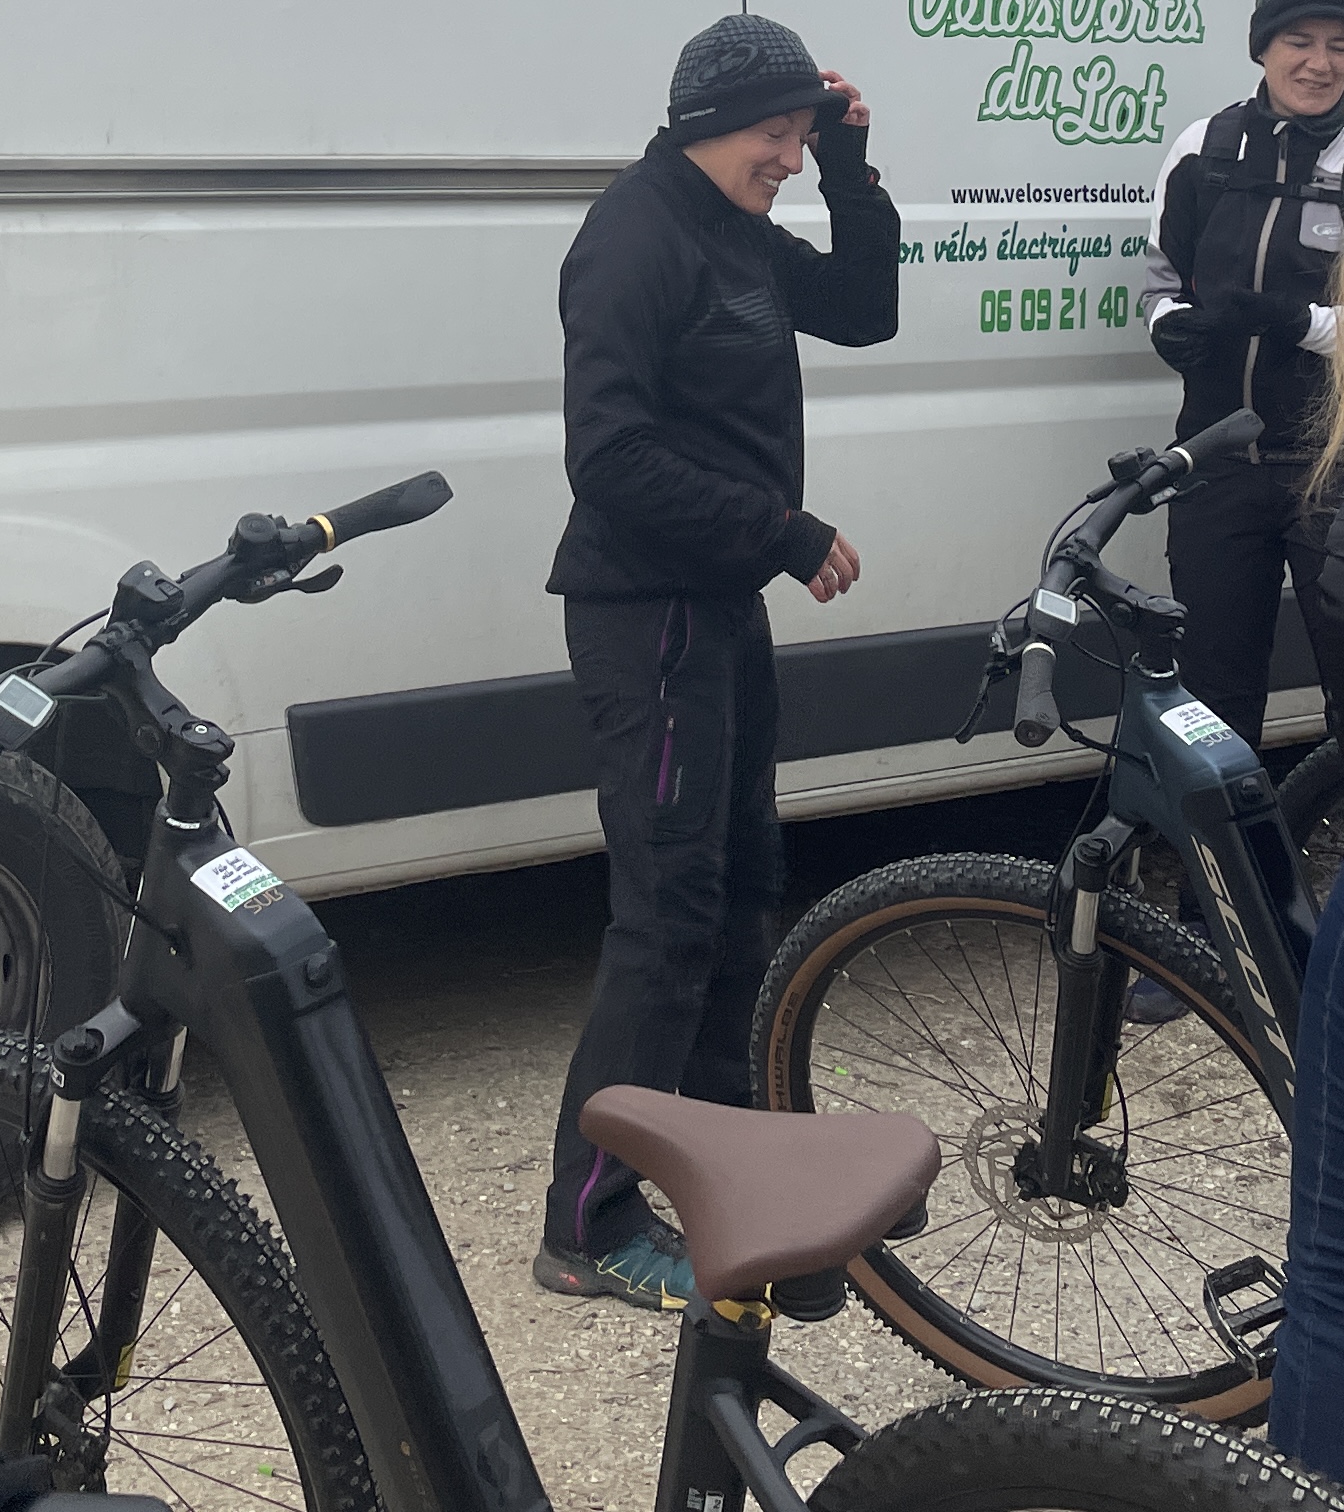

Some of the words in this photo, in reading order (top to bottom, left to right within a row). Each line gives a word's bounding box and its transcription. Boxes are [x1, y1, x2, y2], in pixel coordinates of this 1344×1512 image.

[977, 39, 1063, 121] du
[1053, 55, 1167, 145] Lot
[934, 222, 987, 263] vélos
[996, 221, 1112, 277] électriques
[980, 289, 1012, 333] 06
[1020, 288, 1051, 331] 09
[1059, 287, 1086, 330] 21
[1098, 285, 1128, 328] 40
[1190, 834, 1296, 1098] SCOT
